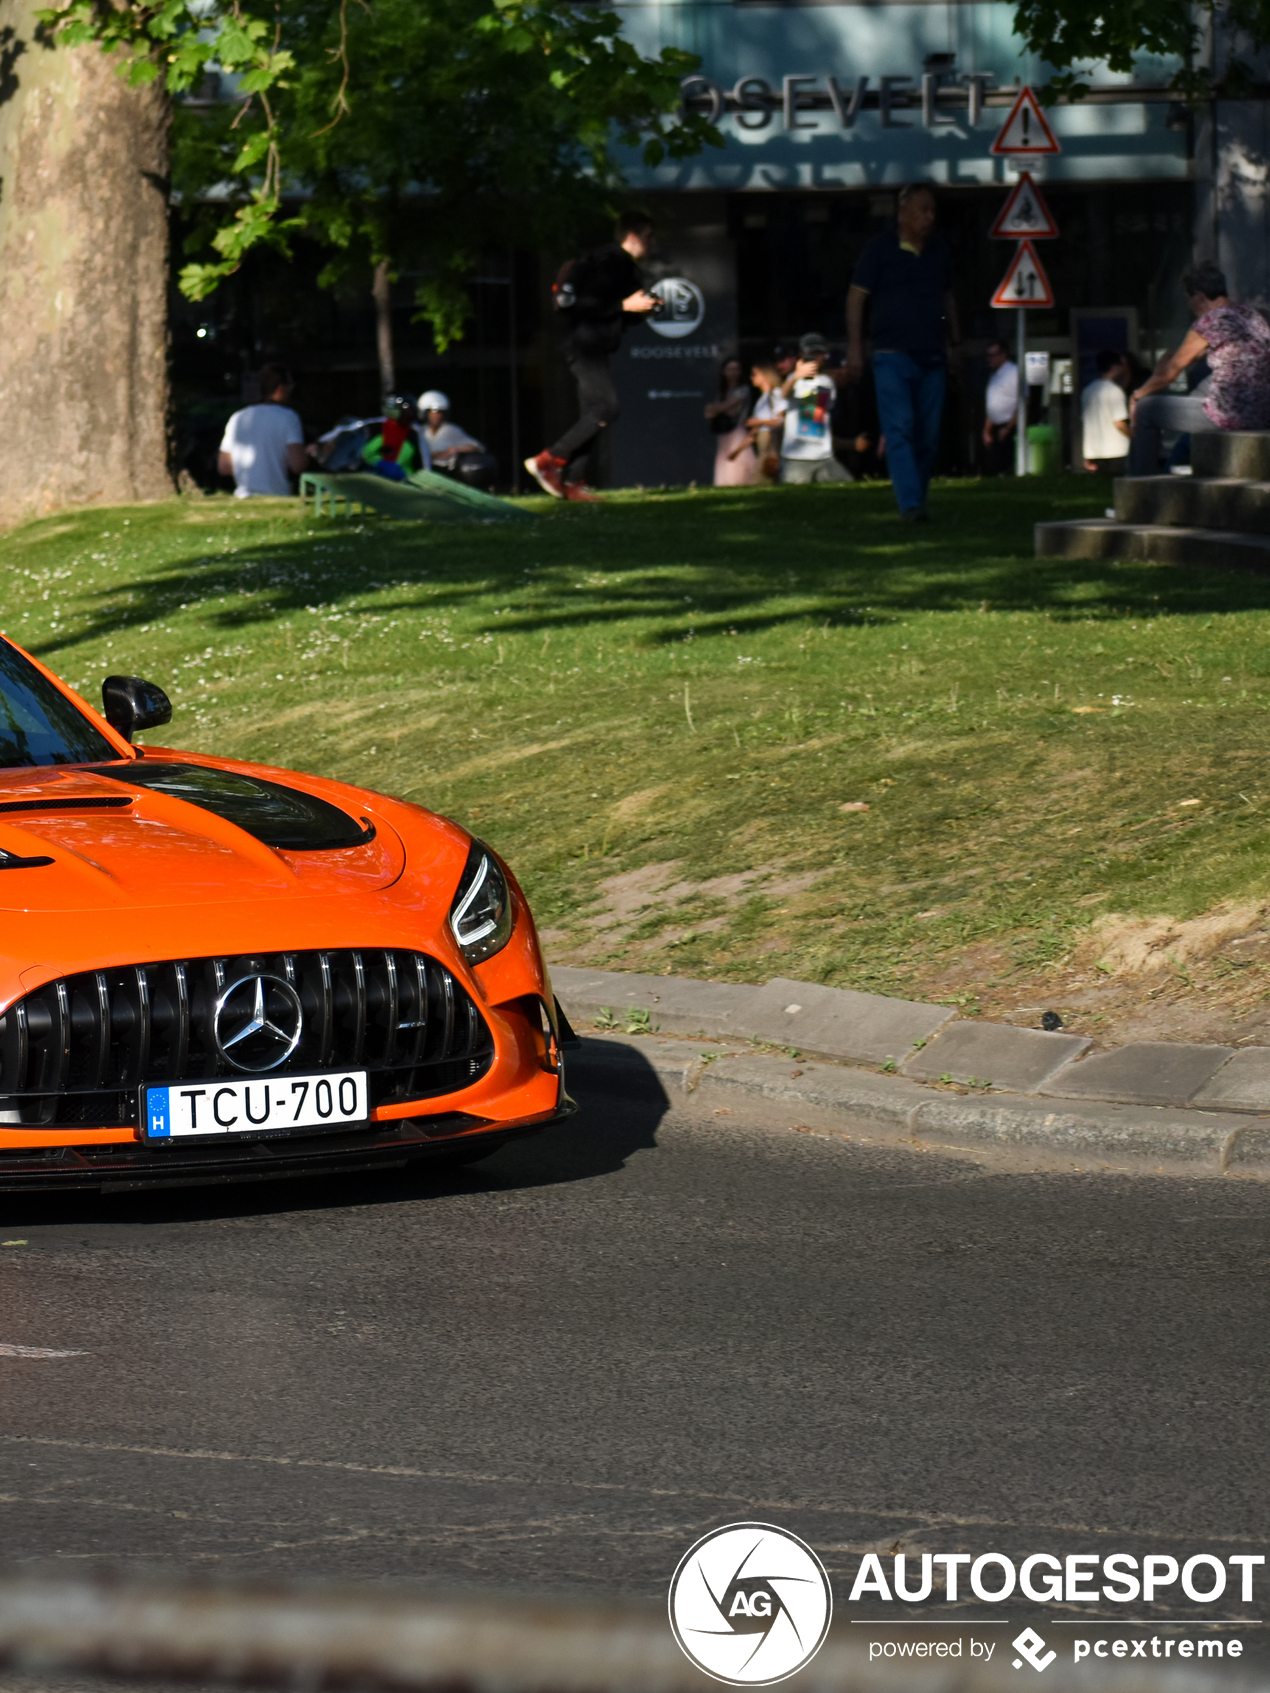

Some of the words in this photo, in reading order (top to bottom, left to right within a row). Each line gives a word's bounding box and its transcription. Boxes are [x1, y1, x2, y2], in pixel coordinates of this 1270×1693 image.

[679, 71, 994, 130] OSEVELT
[152, 1116, 164, 1131] H
[180, 1077, 357, 1129] TCU-700
